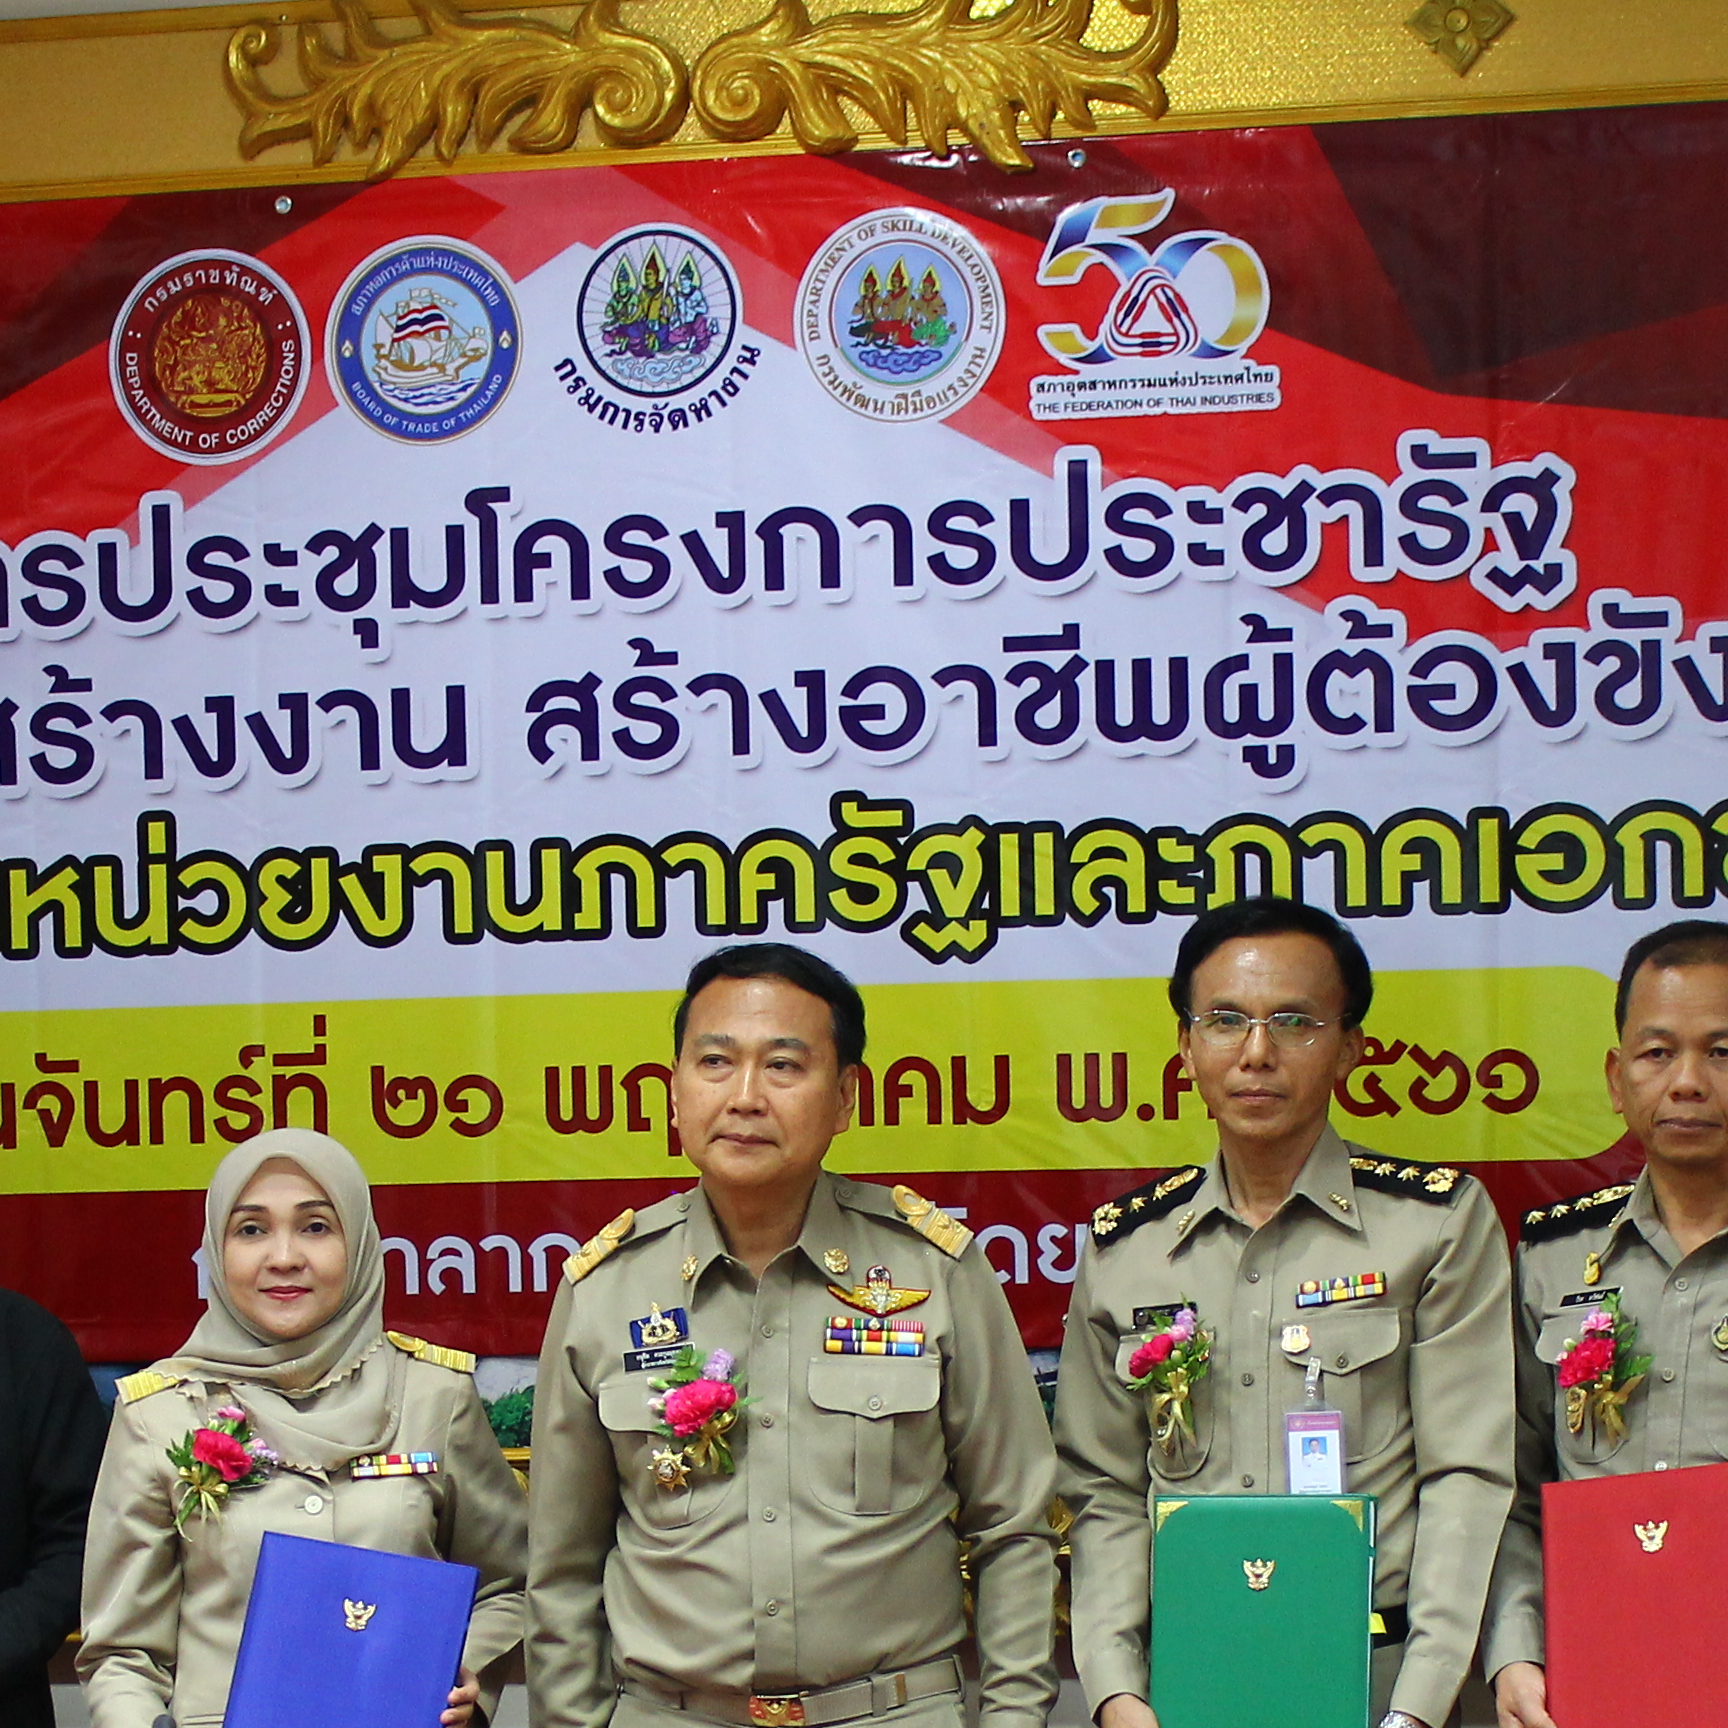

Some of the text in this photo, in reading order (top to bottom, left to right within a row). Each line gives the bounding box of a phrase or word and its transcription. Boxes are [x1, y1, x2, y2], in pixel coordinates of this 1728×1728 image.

[806, 236, 856, 343] DEPARTMENT
[857, 223, 876, 242] OF
[881, 218, 929, 236] SKILL
[126, 339, 295, 449] DEPARTMENT OF CORRECTIONS
[351, 373, 503, 434] BOARD OF TRADE OF THAILAND
[552, 342, 762, 434] กรมการจัดหางาน
[815, 346, 987, 416] กรมพัฒนาฝีมือแรงงาน
[1035, 366, 1275, 398] สภาอุตสาหกรรมแห่งประเทศไทย
[1035, 392, 1275, 414] THE FEDERATION OF THAI INDUSTRIES
[370, 1065, 504, 1139] ๒๑
[543, 1054, 1011, 1157] พฤาคม
[1333, 1036, 1540, 1119] ๕๖๑
